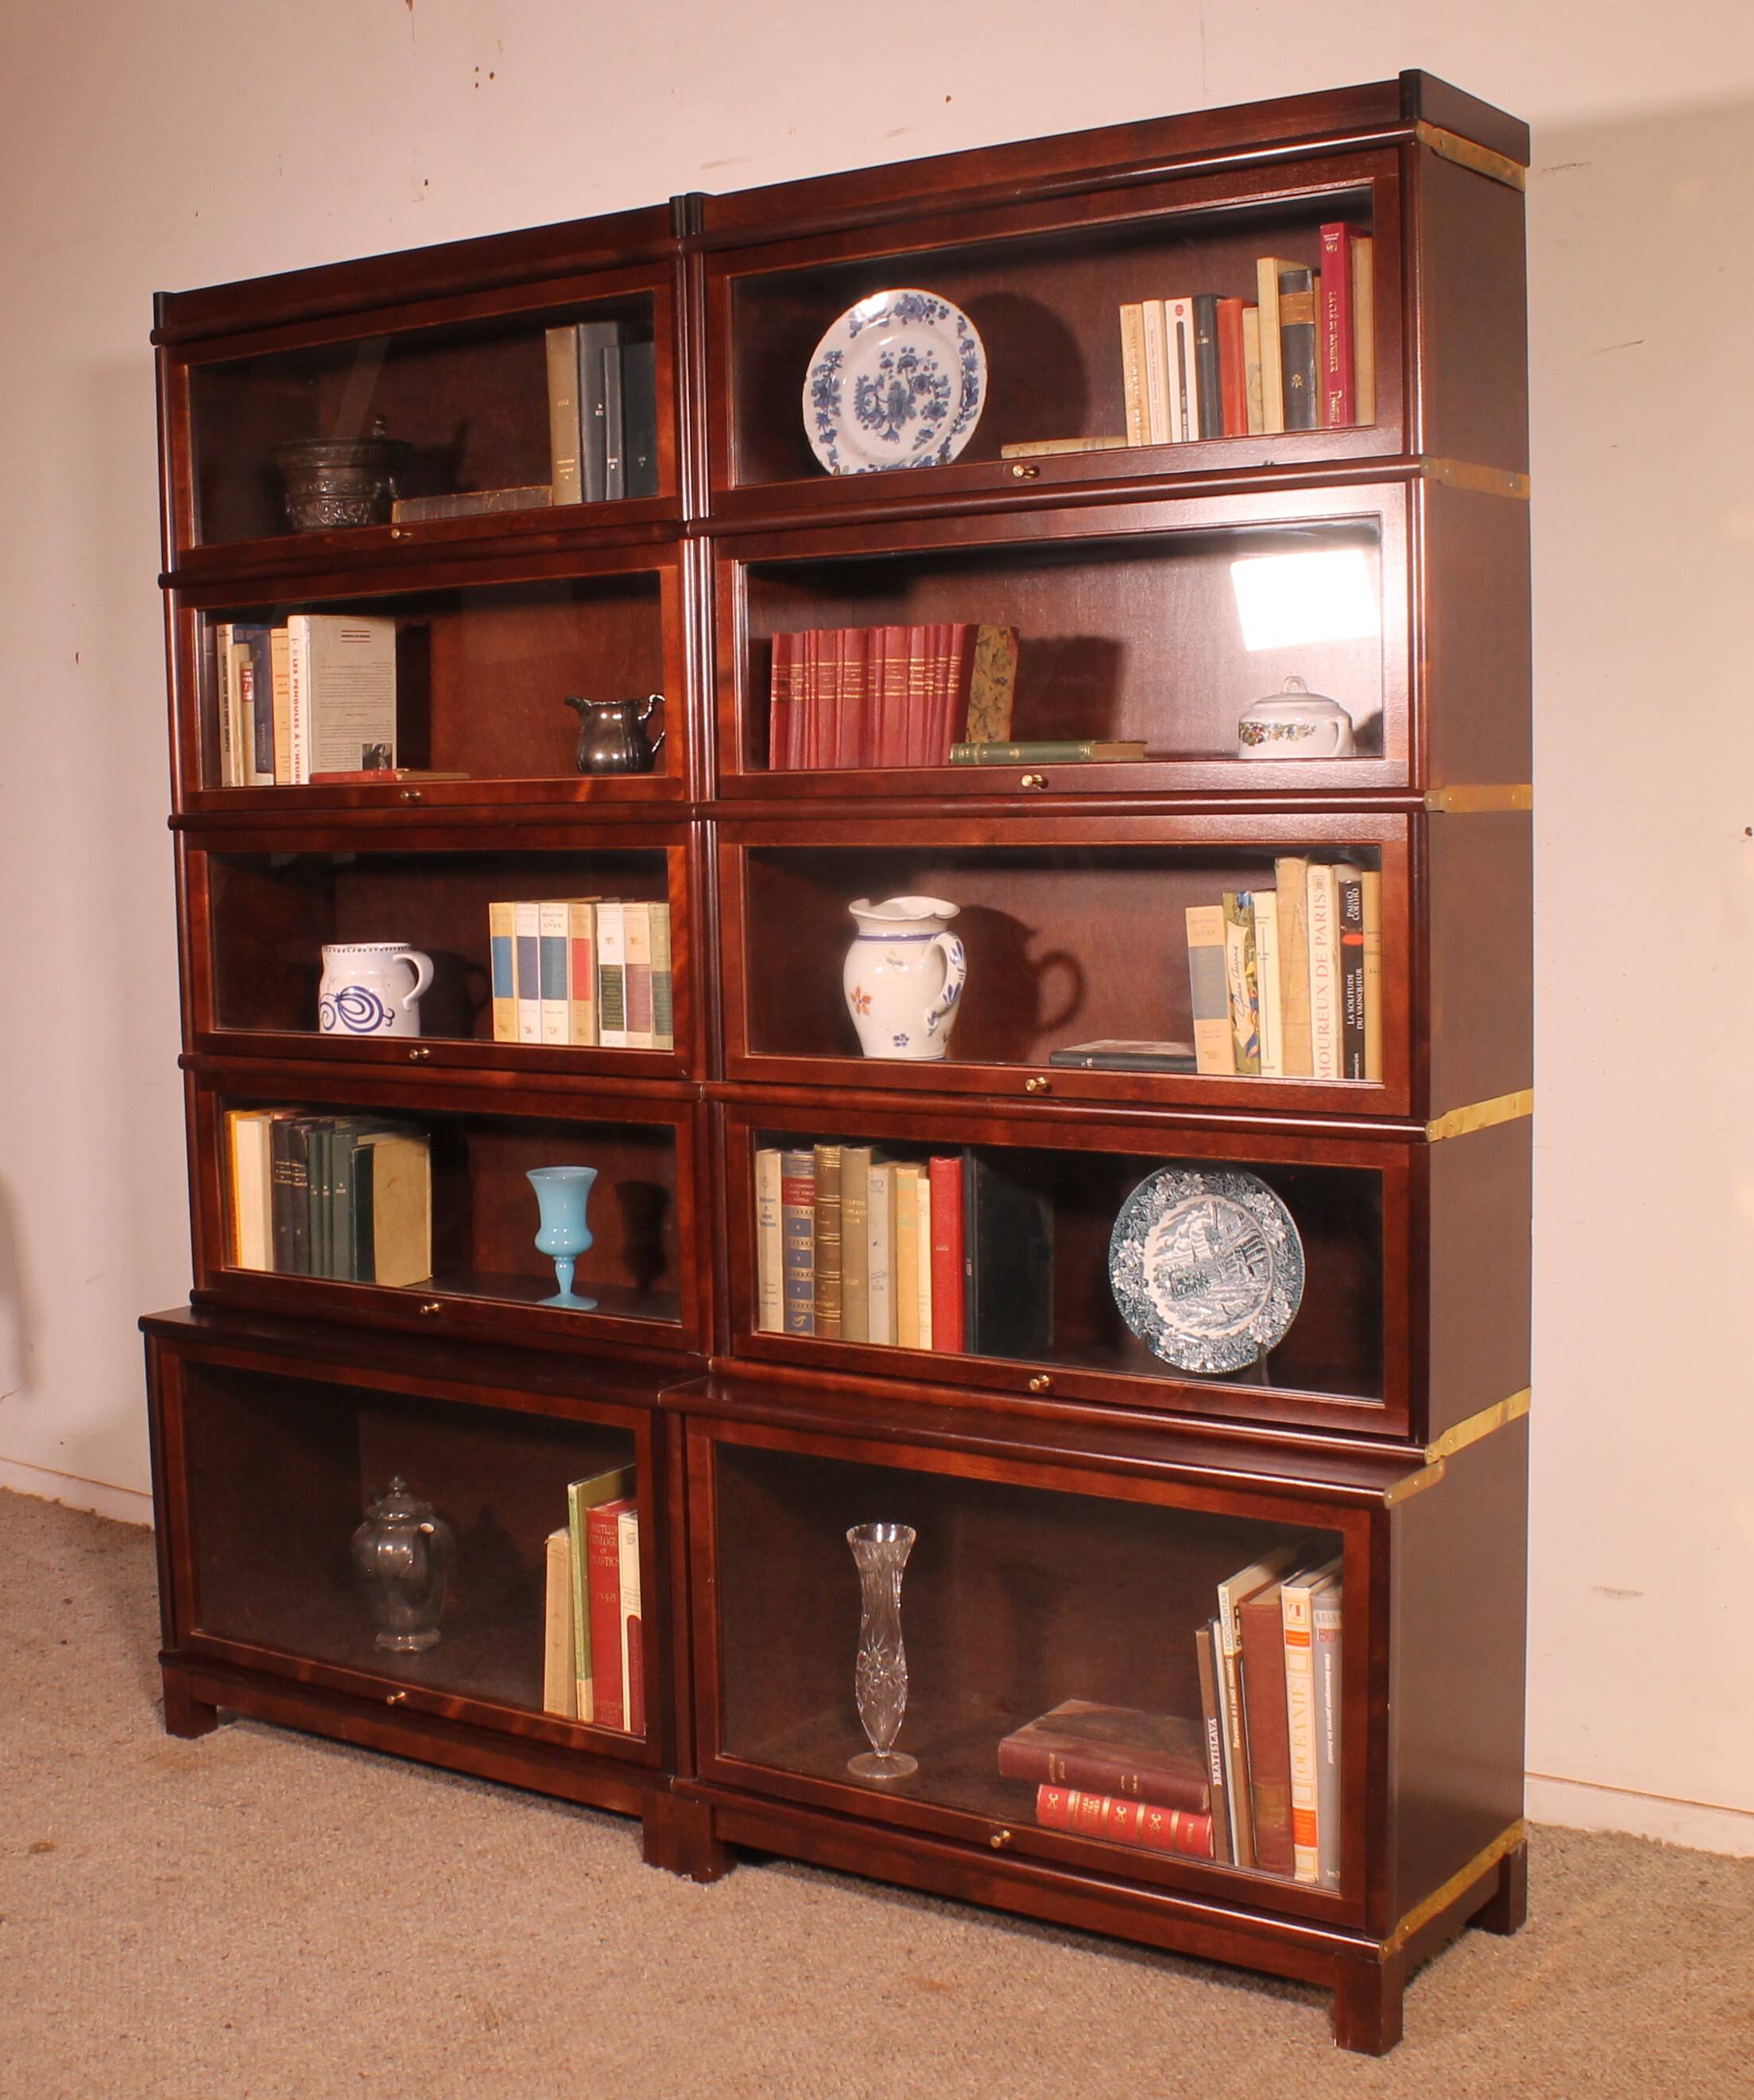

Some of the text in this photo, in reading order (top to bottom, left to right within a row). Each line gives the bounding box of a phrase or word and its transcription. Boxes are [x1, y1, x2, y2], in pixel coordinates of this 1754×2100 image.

[1314, 893, 1328, 945] PARIS
[1315, 951, 1329, 978] DE
[1346, 973, 1355, 1025] LA SOLITUDE
[1355, 967, 1364, 1030] DU VAINQUEUR
[1221, 1590, 1232, 1647] DOCUMENTARI
[1226, 1659, 1236, 1687] mosaici
[1207, 1717, 1222, 1787] BRATISLAVA
[1293, 1683, 1308, 1774] OCEANIE
